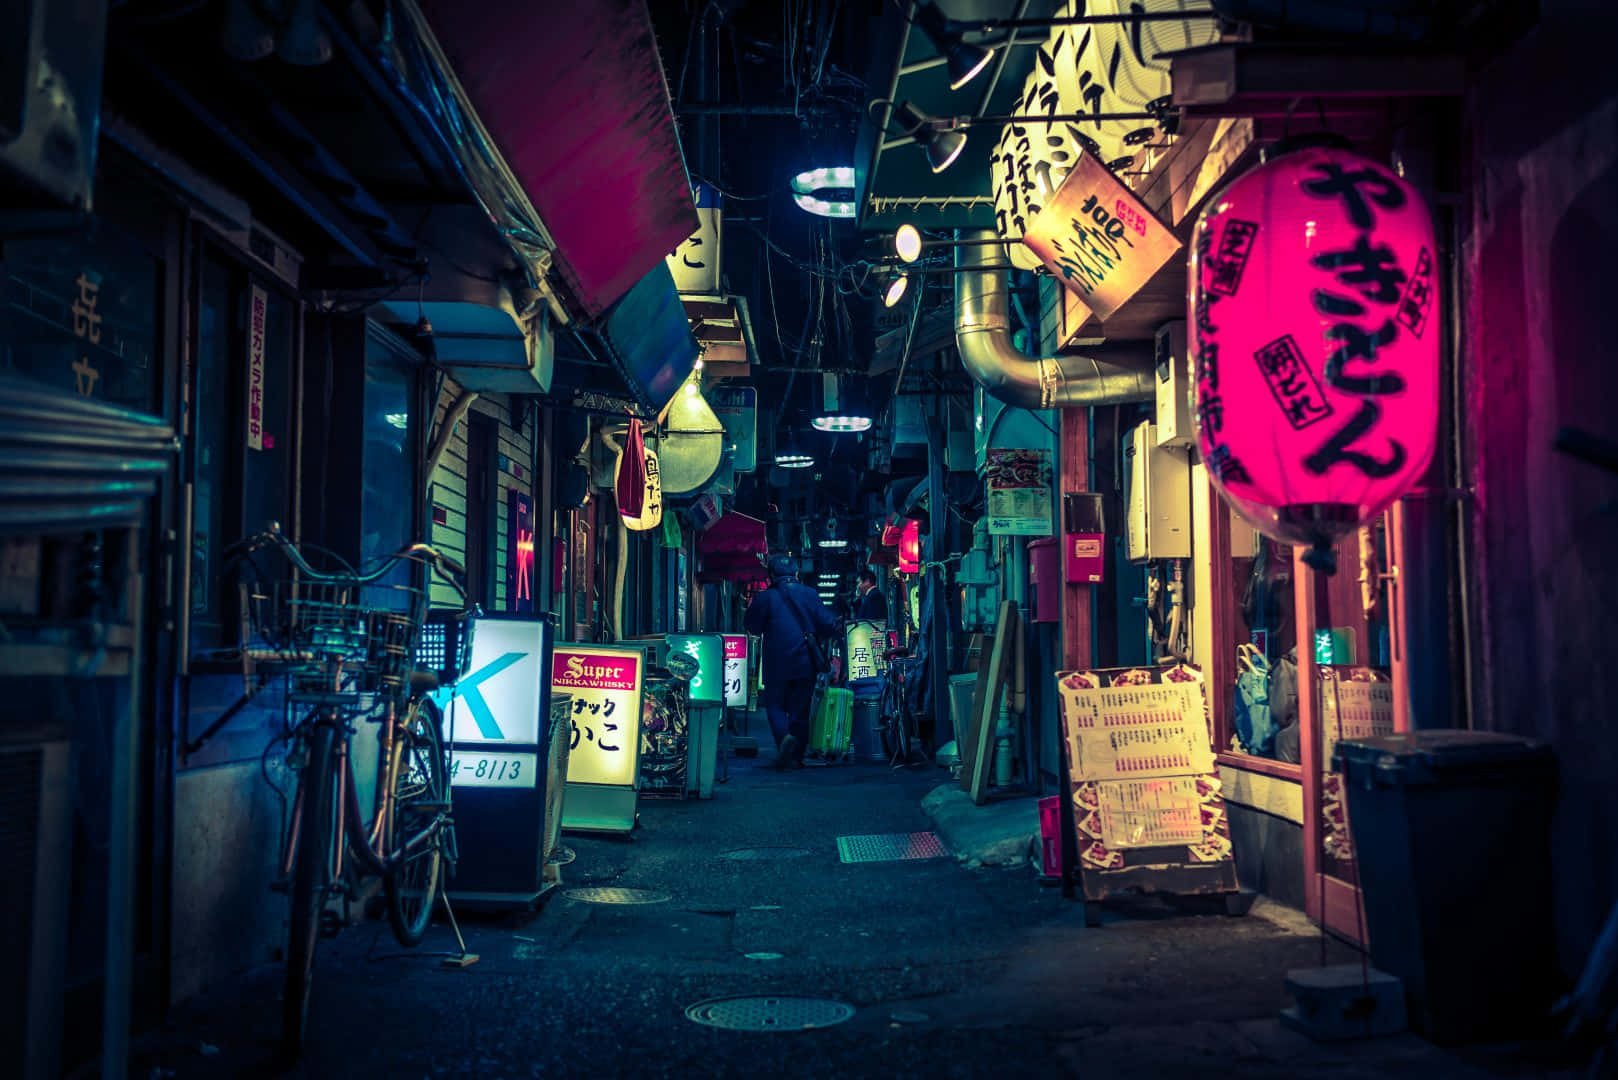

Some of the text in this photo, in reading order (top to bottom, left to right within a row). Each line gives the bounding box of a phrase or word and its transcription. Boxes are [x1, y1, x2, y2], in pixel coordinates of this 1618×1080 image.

[1299, 161, 1409, 478] やきとん
[249, 295, 265, 440] 防犯カメラ作動中
[552, 677, 634, 689] NIKKA WHISKY
[562, 655, 624, 680] Super
